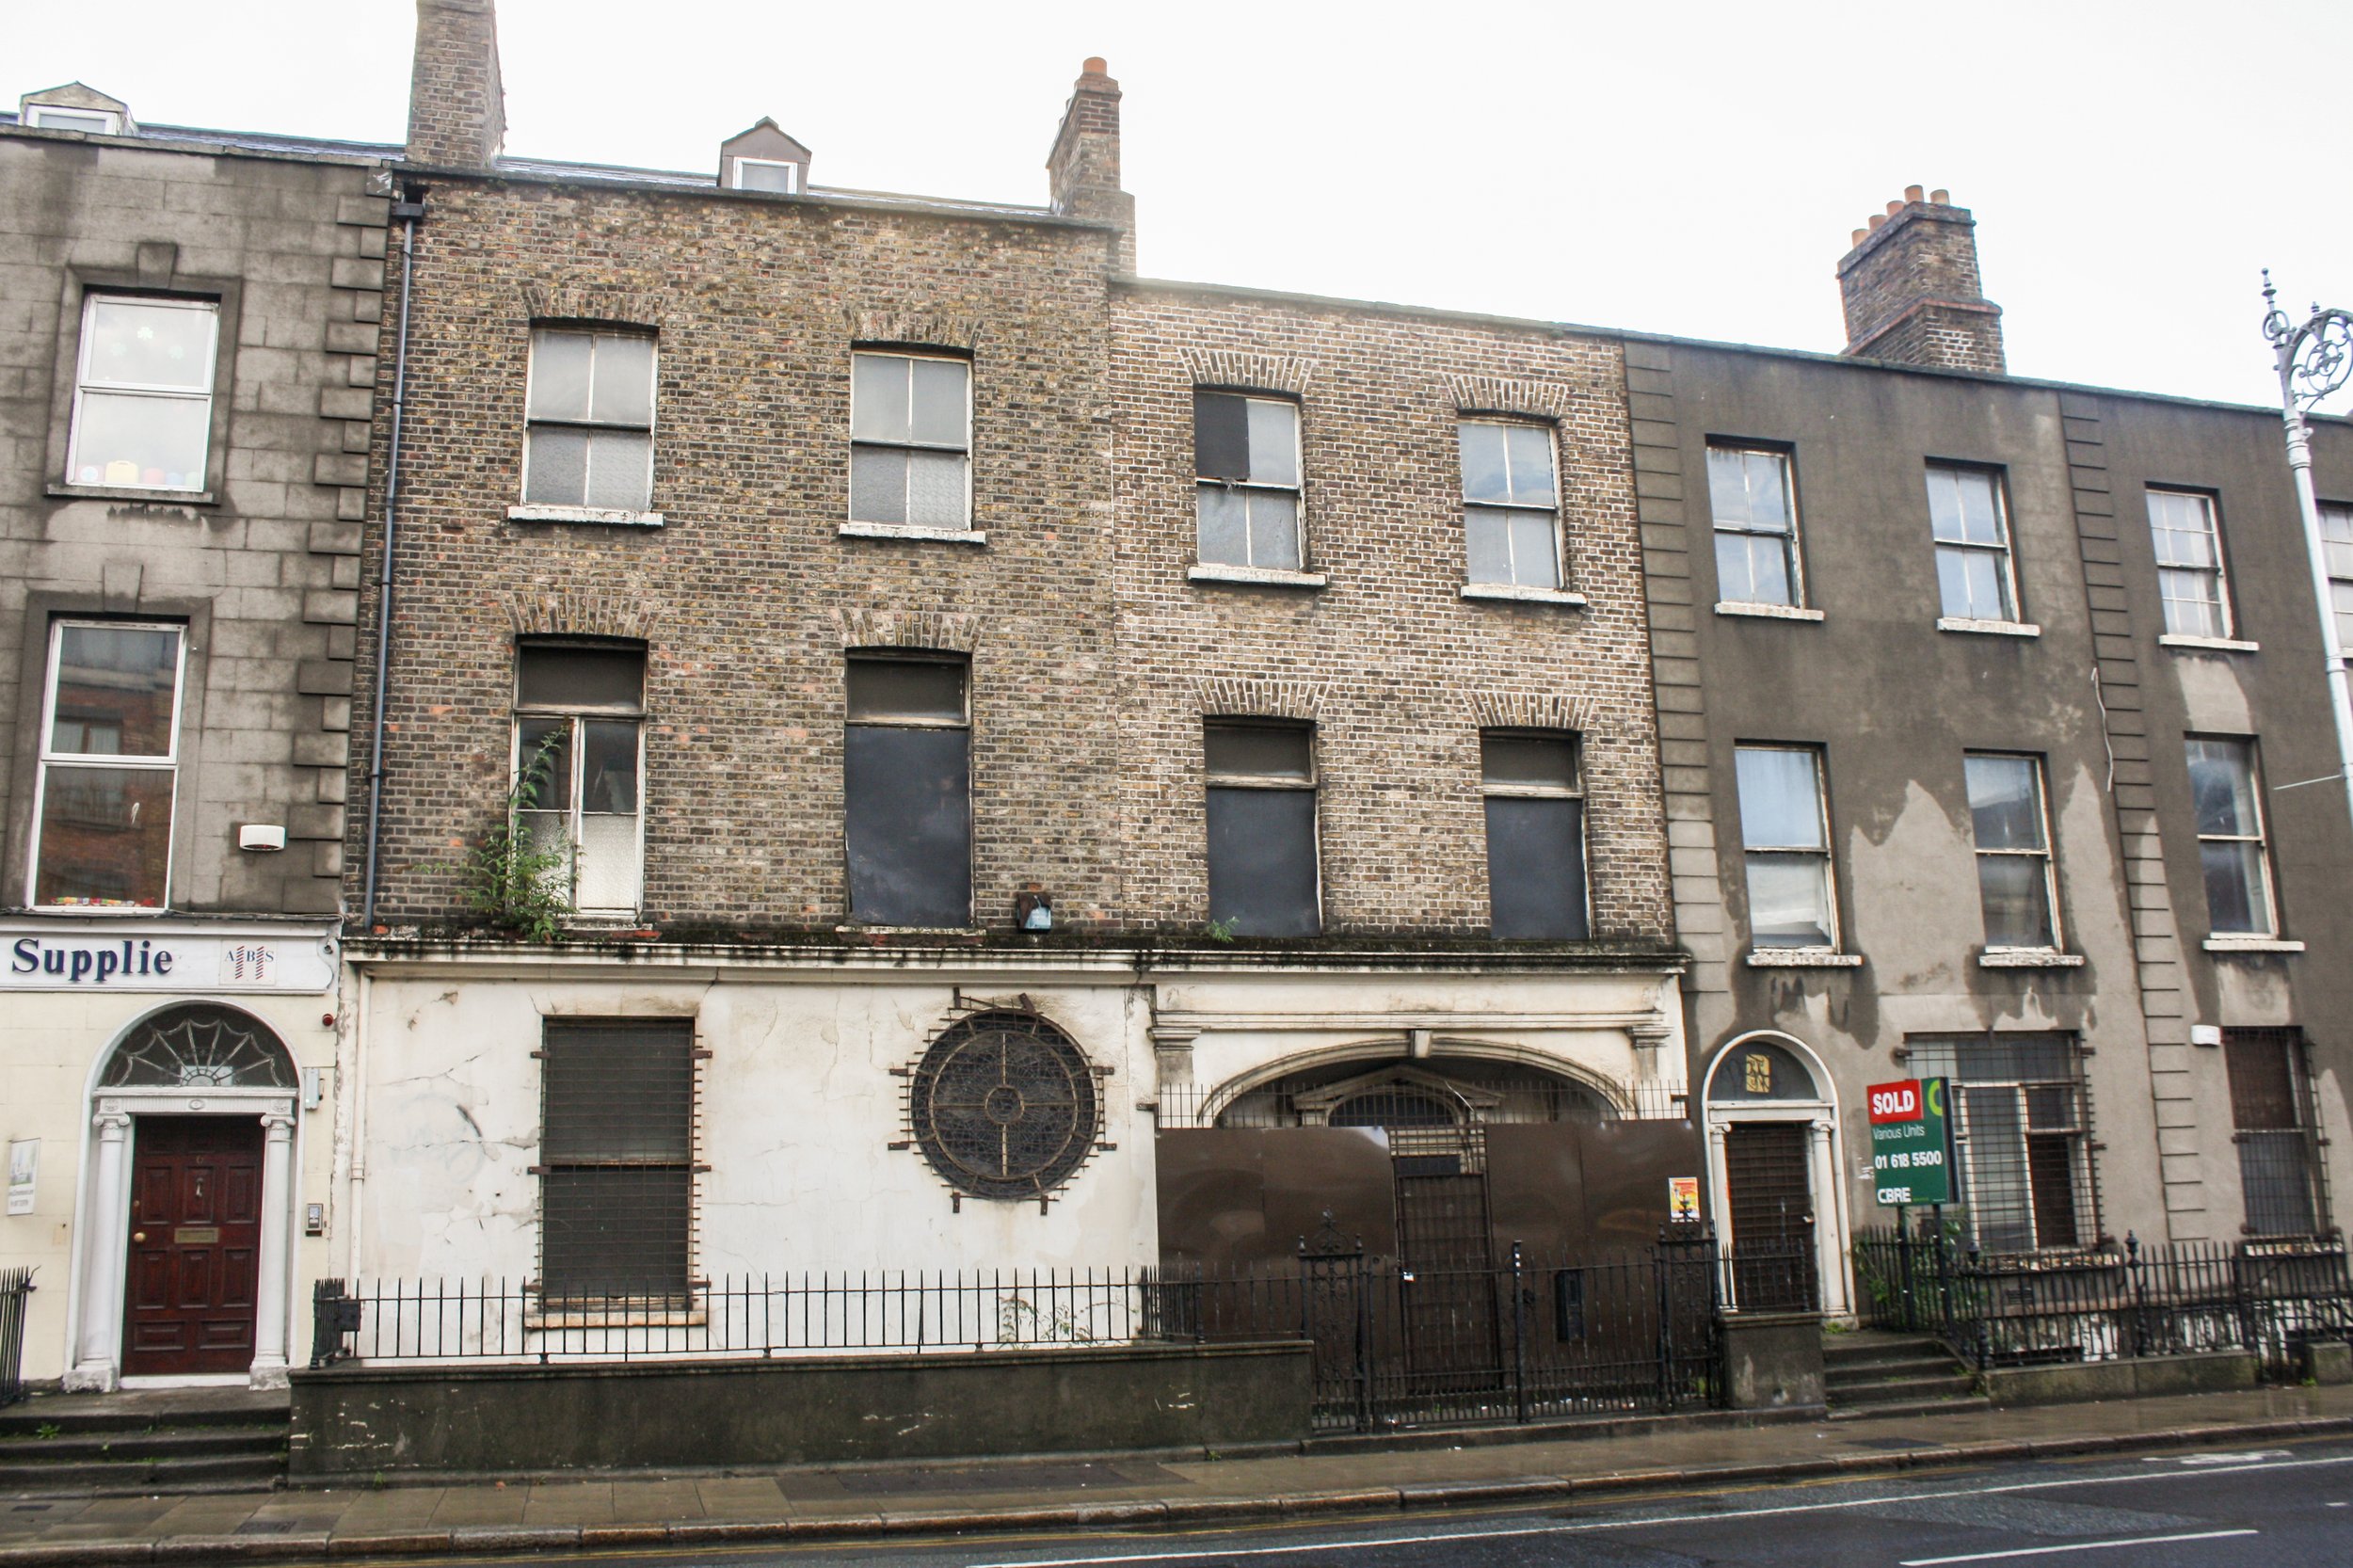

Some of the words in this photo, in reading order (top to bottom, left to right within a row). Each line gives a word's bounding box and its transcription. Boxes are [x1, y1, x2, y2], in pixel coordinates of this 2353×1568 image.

[11, 938, 173, 982] Supplie
[1873, 1090, 1914, 1114] SOLD
[1873, 1127, 1901, 1140] Various
[1903, 1124, 1925, 1137] Units
[1875, 1155, 1888, 1169] 01
[1891, 1153, 1910, 1168] 618
[1912, 1150, 1942, 1166] 5500
[1877, 1187, 1912, 1204] CBRE
